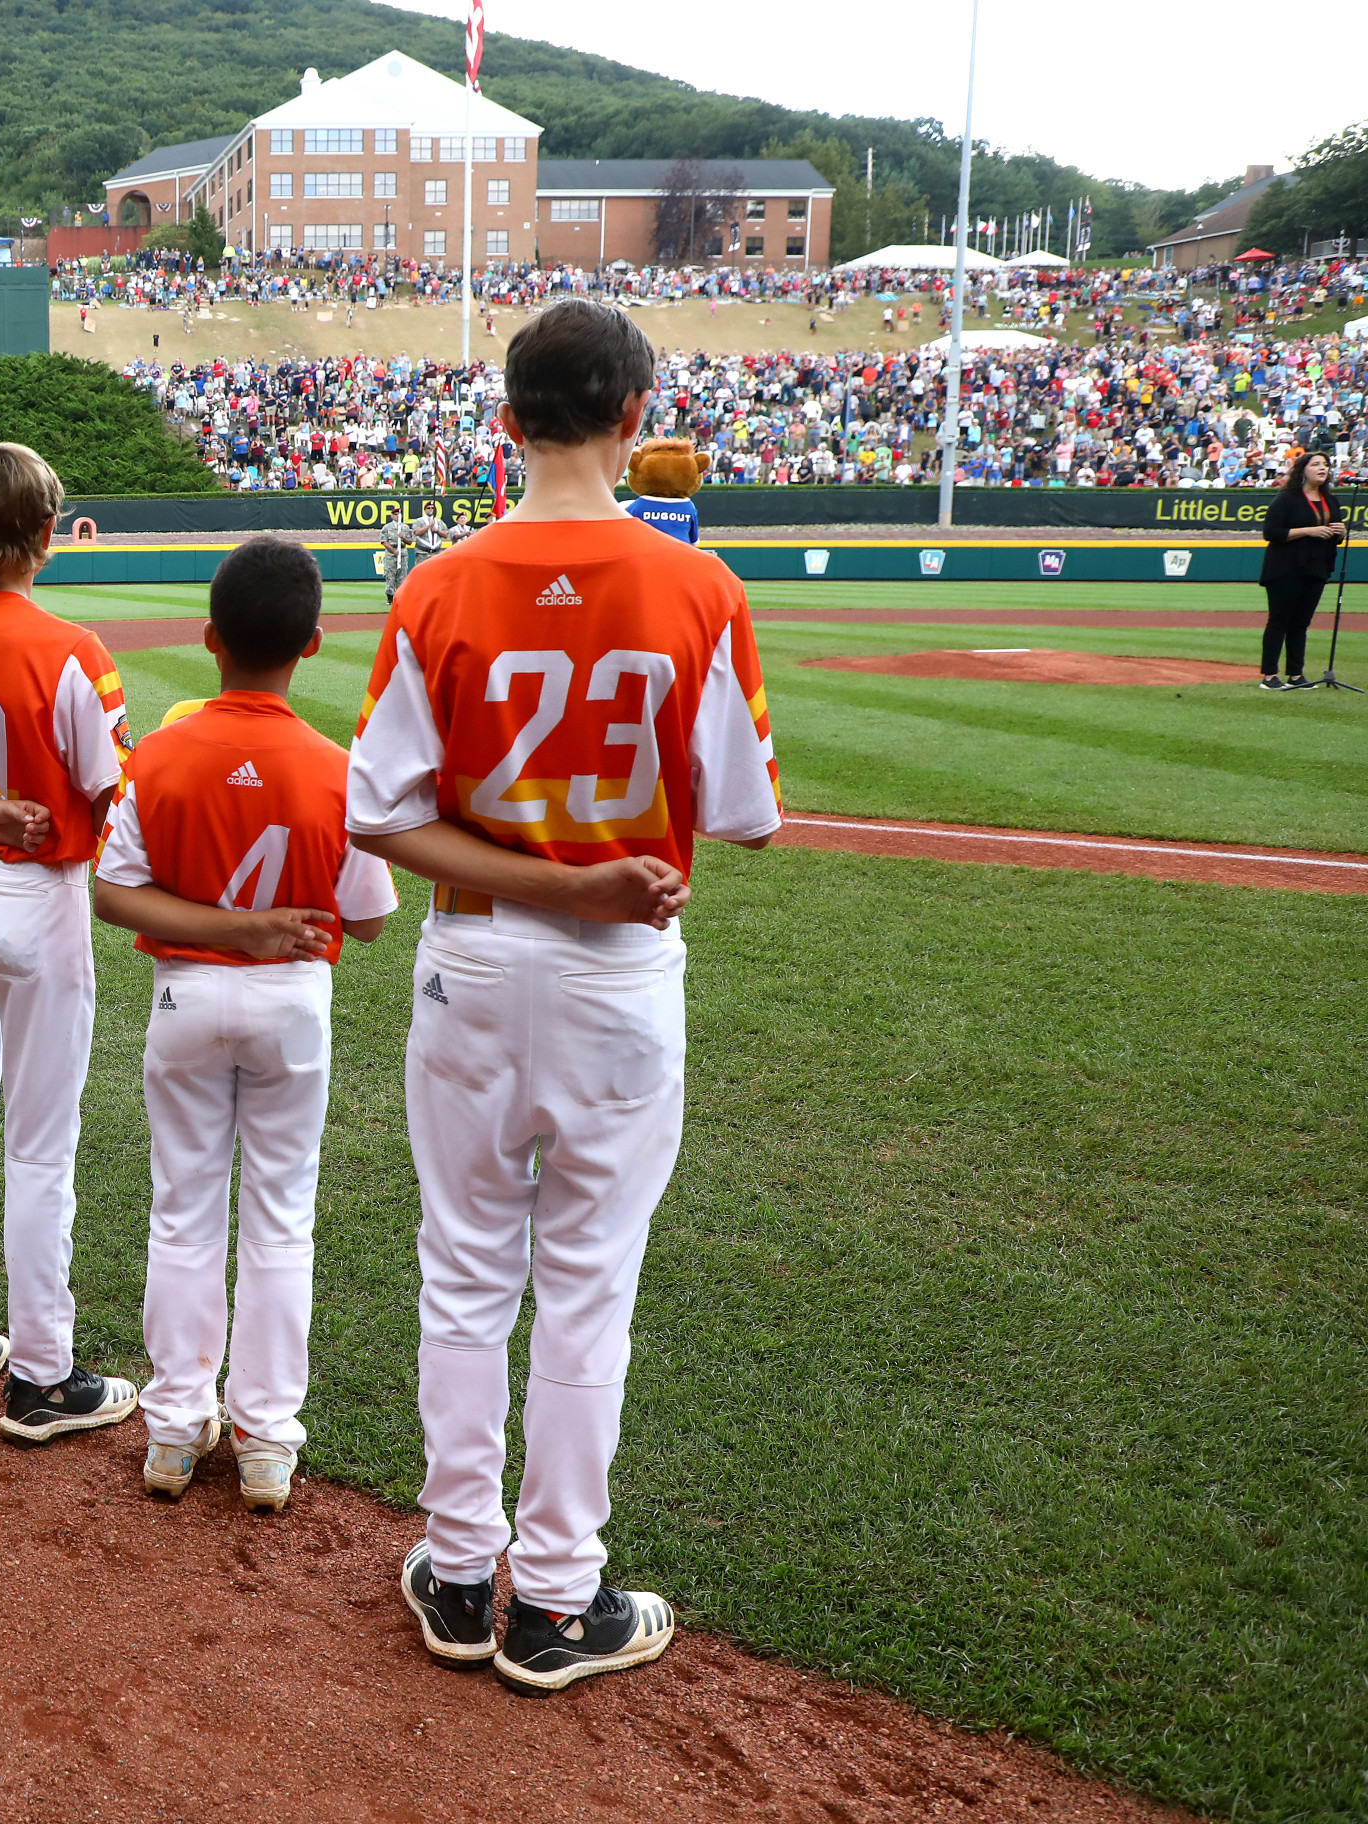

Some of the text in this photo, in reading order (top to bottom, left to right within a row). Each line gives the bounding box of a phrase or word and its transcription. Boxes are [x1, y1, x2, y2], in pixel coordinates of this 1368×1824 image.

[643, 511, 691, 522] DUGOUT
[1170, 555, 1186, 569] Ap
[536, 593, 583, 606] adidas
[470, 649, 676, 823] 23
[226, 776, 264, 788] adidas
[217, 824, 291, 912] 4
[422, 986, 449, 1005] adidas
